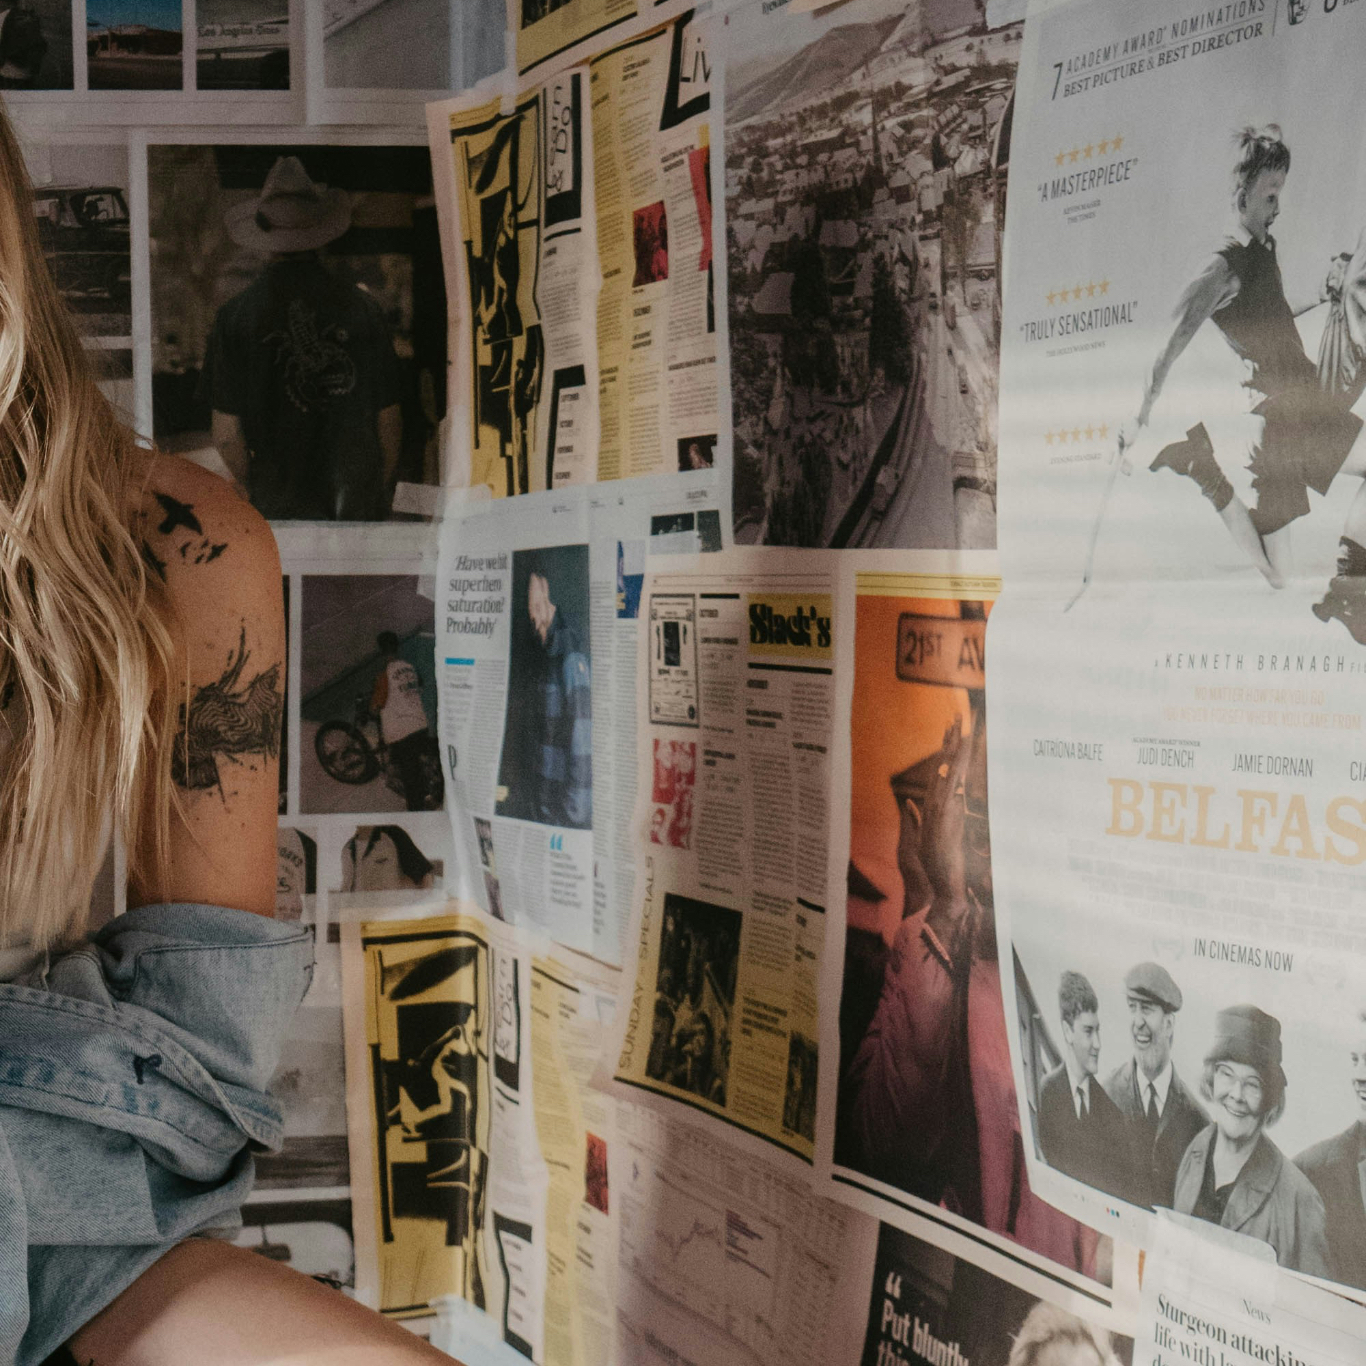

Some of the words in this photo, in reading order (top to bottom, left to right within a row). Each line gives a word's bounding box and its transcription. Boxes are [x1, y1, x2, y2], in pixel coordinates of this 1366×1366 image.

[1051, 62, 1064, 102] 7
[1065, 39, 1120, 75] ACADEMY
[1062, 75, 1092, 99] BEST
[1091, 57, 1146, 88] PICTURE
[1156, 43, 1190, 70] BEST
[1190, 20, 1265, 58] DIRECTOR
[1164, 652, 1245, 672] KENNETH
[1256, 653, 1346, 674] BRANAGH
[1076, 741, 1104, 763] BALFE
[1136, 746, 1159, 767] JUDI
[1159, 747, 1196, 769] DENCH
[1231, 752, 1265, 775] JAMIE
[1265, 754, 1314, 779] DORNAN
[1193, 937, 1207, 958] IN
[1208, 939, 1263, 969] CINEMAS
[1263, 948, 1295, 974] NOW
[617, 977, 642, 1071] SUNDAY
[880, 1298, 911, 1348] Put
[1155, 1292, 1228, 1346] Sturgeon
[1241, 1297, 1273, 1326] News
[1153, 1321, 1177, 1353] life
